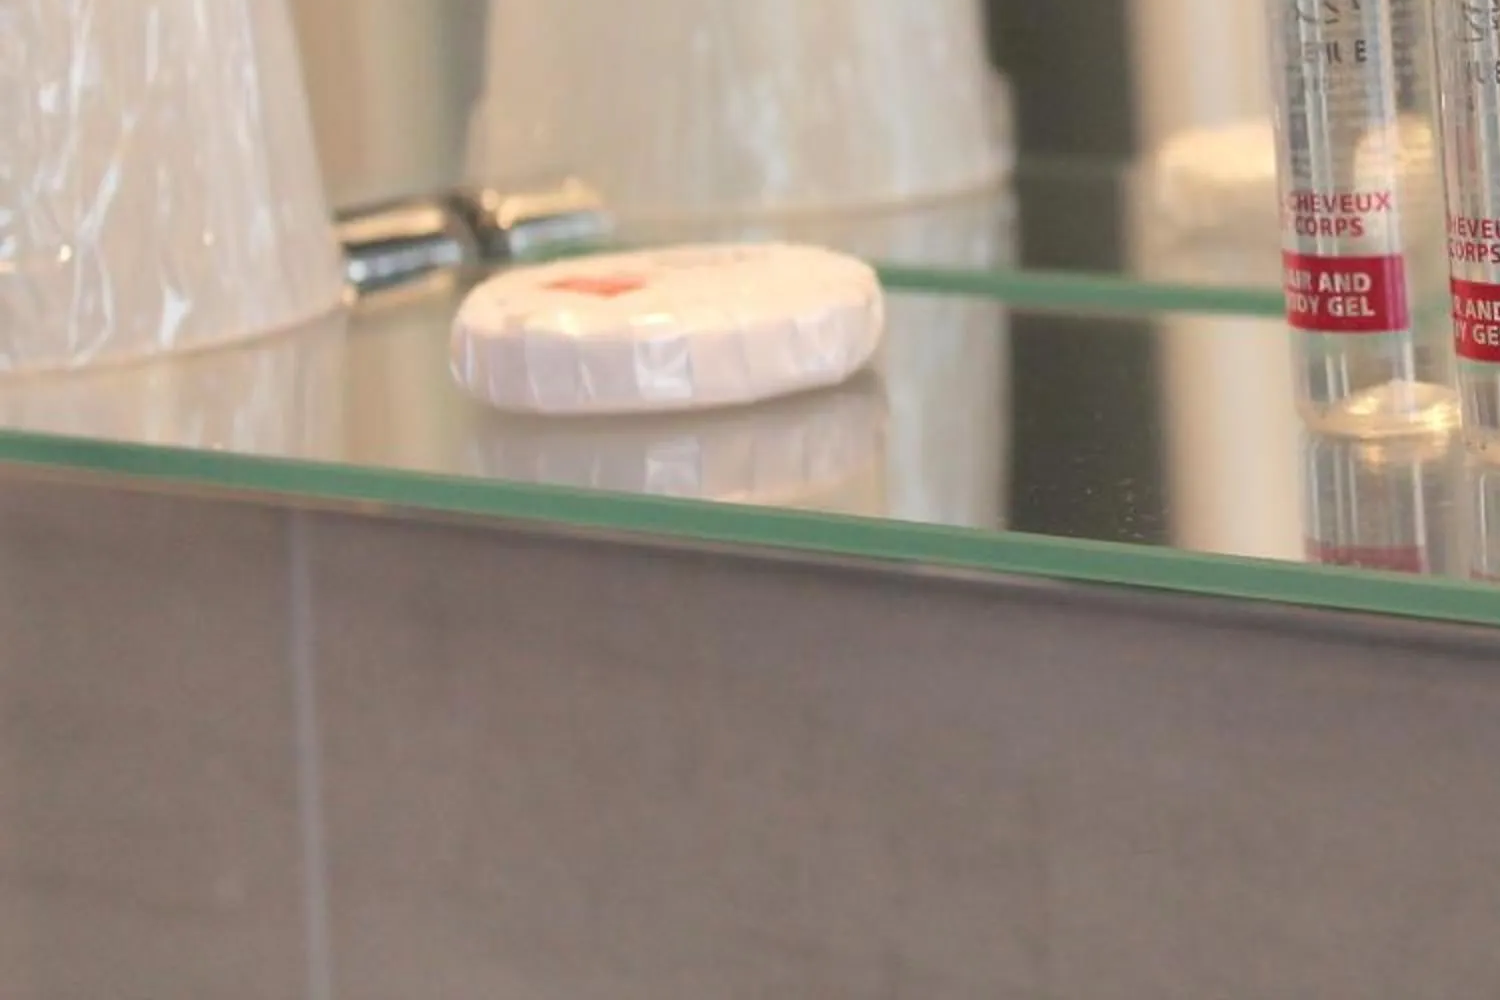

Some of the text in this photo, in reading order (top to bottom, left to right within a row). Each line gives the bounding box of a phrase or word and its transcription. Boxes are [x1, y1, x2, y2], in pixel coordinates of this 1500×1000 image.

[1295, 215, 1365, 238] CORPS
[1317, 271, 1373, 293] AND
[1327, 295, 1376, 317] GEL
